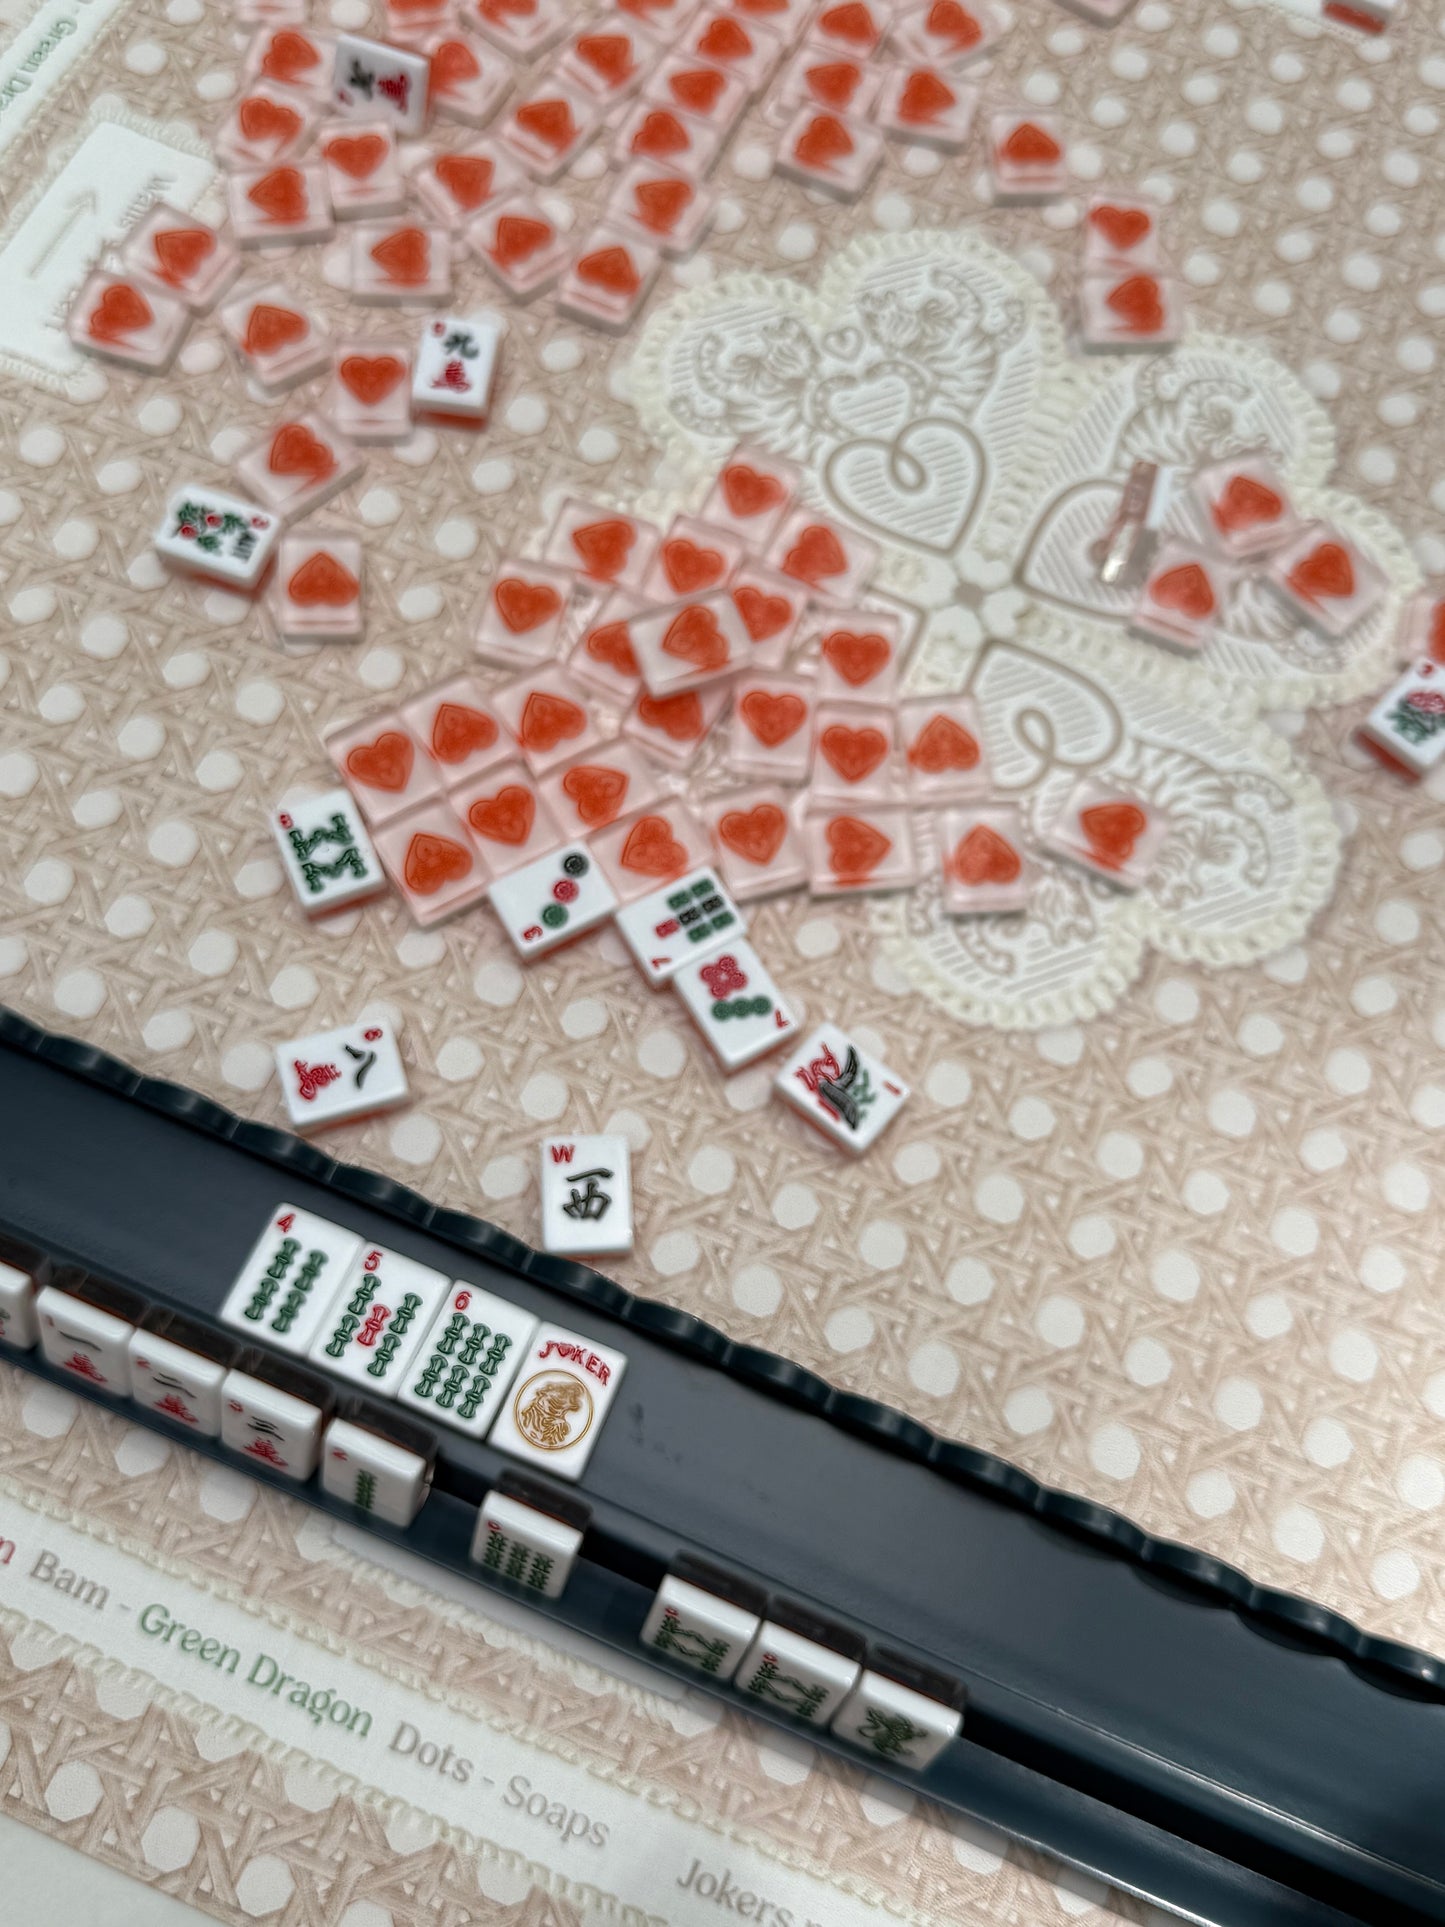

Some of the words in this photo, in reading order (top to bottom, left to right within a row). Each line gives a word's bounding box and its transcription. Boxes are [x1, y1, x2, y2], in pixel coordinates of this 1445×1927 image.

[18, 16, 78, 73] Green
[522, 925, 544, 941] 3
[551, 1145, 576, 1164] W
[563, 1167, 614, 1221] 西
[277, 1213, 297, 1233] 4
[364, 1251, 384, 1272] 5
[454, 1291, 473, 1310] 6
[29, 1549, 111, 1611] Bam
[139, 1603, 241, 1675] Green
[247, 1653, 374, 1738] Dragon
[388, 1720, 475, 1783] Dots
[502, 1775, 610, 1847] Soaps
[677, 1858, 795, 1927] Jokers
